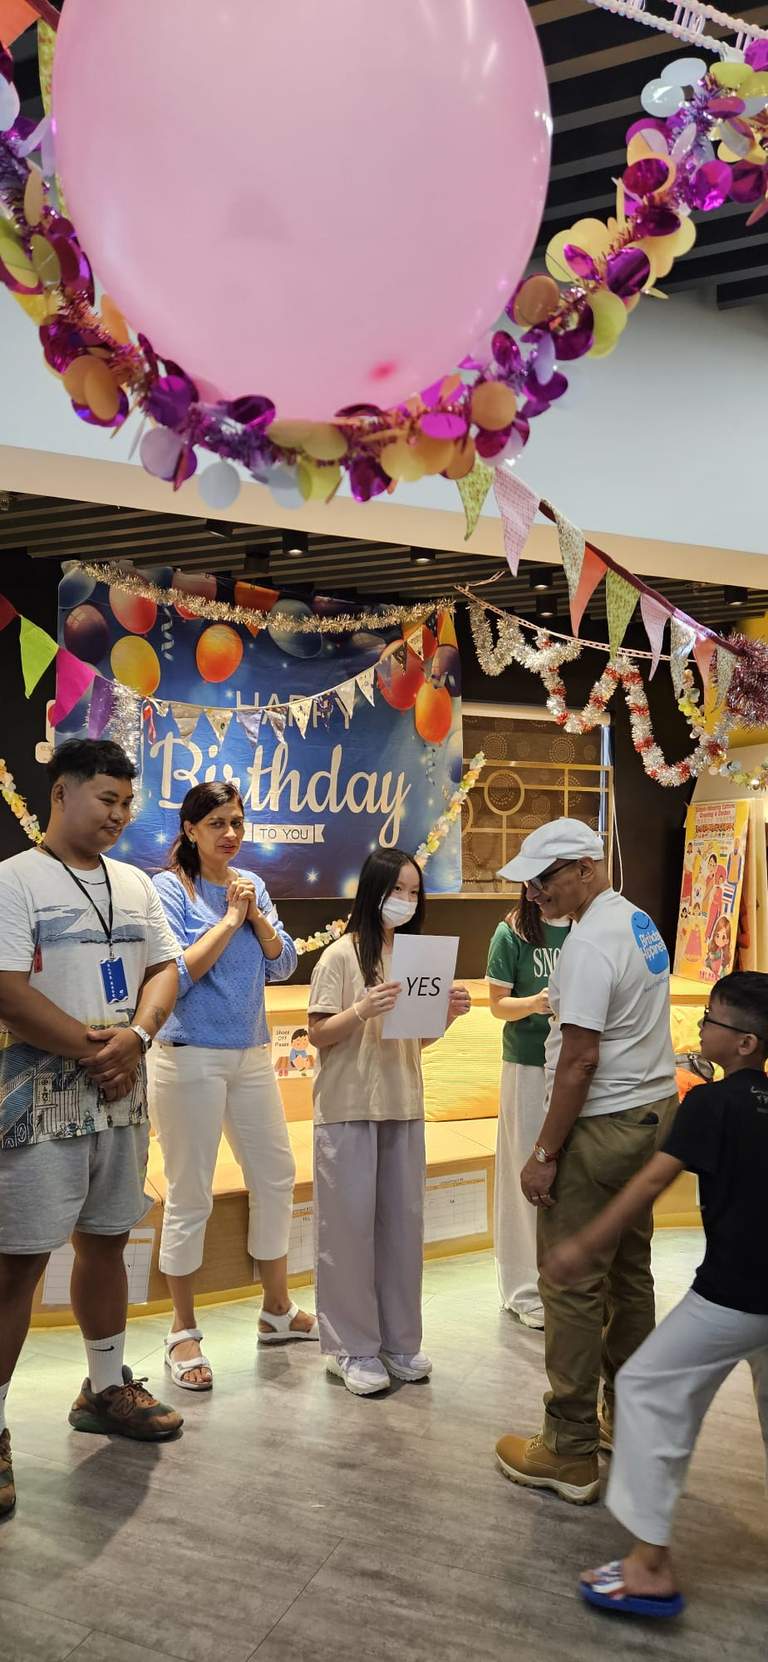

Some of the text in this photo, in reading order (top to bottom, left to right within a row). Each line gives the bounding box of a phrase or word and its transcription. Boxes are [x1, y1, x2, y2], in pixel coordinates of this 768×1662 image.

[260, 828, 308, 840] TO YOU
[406, 976, 441, 997] YES
